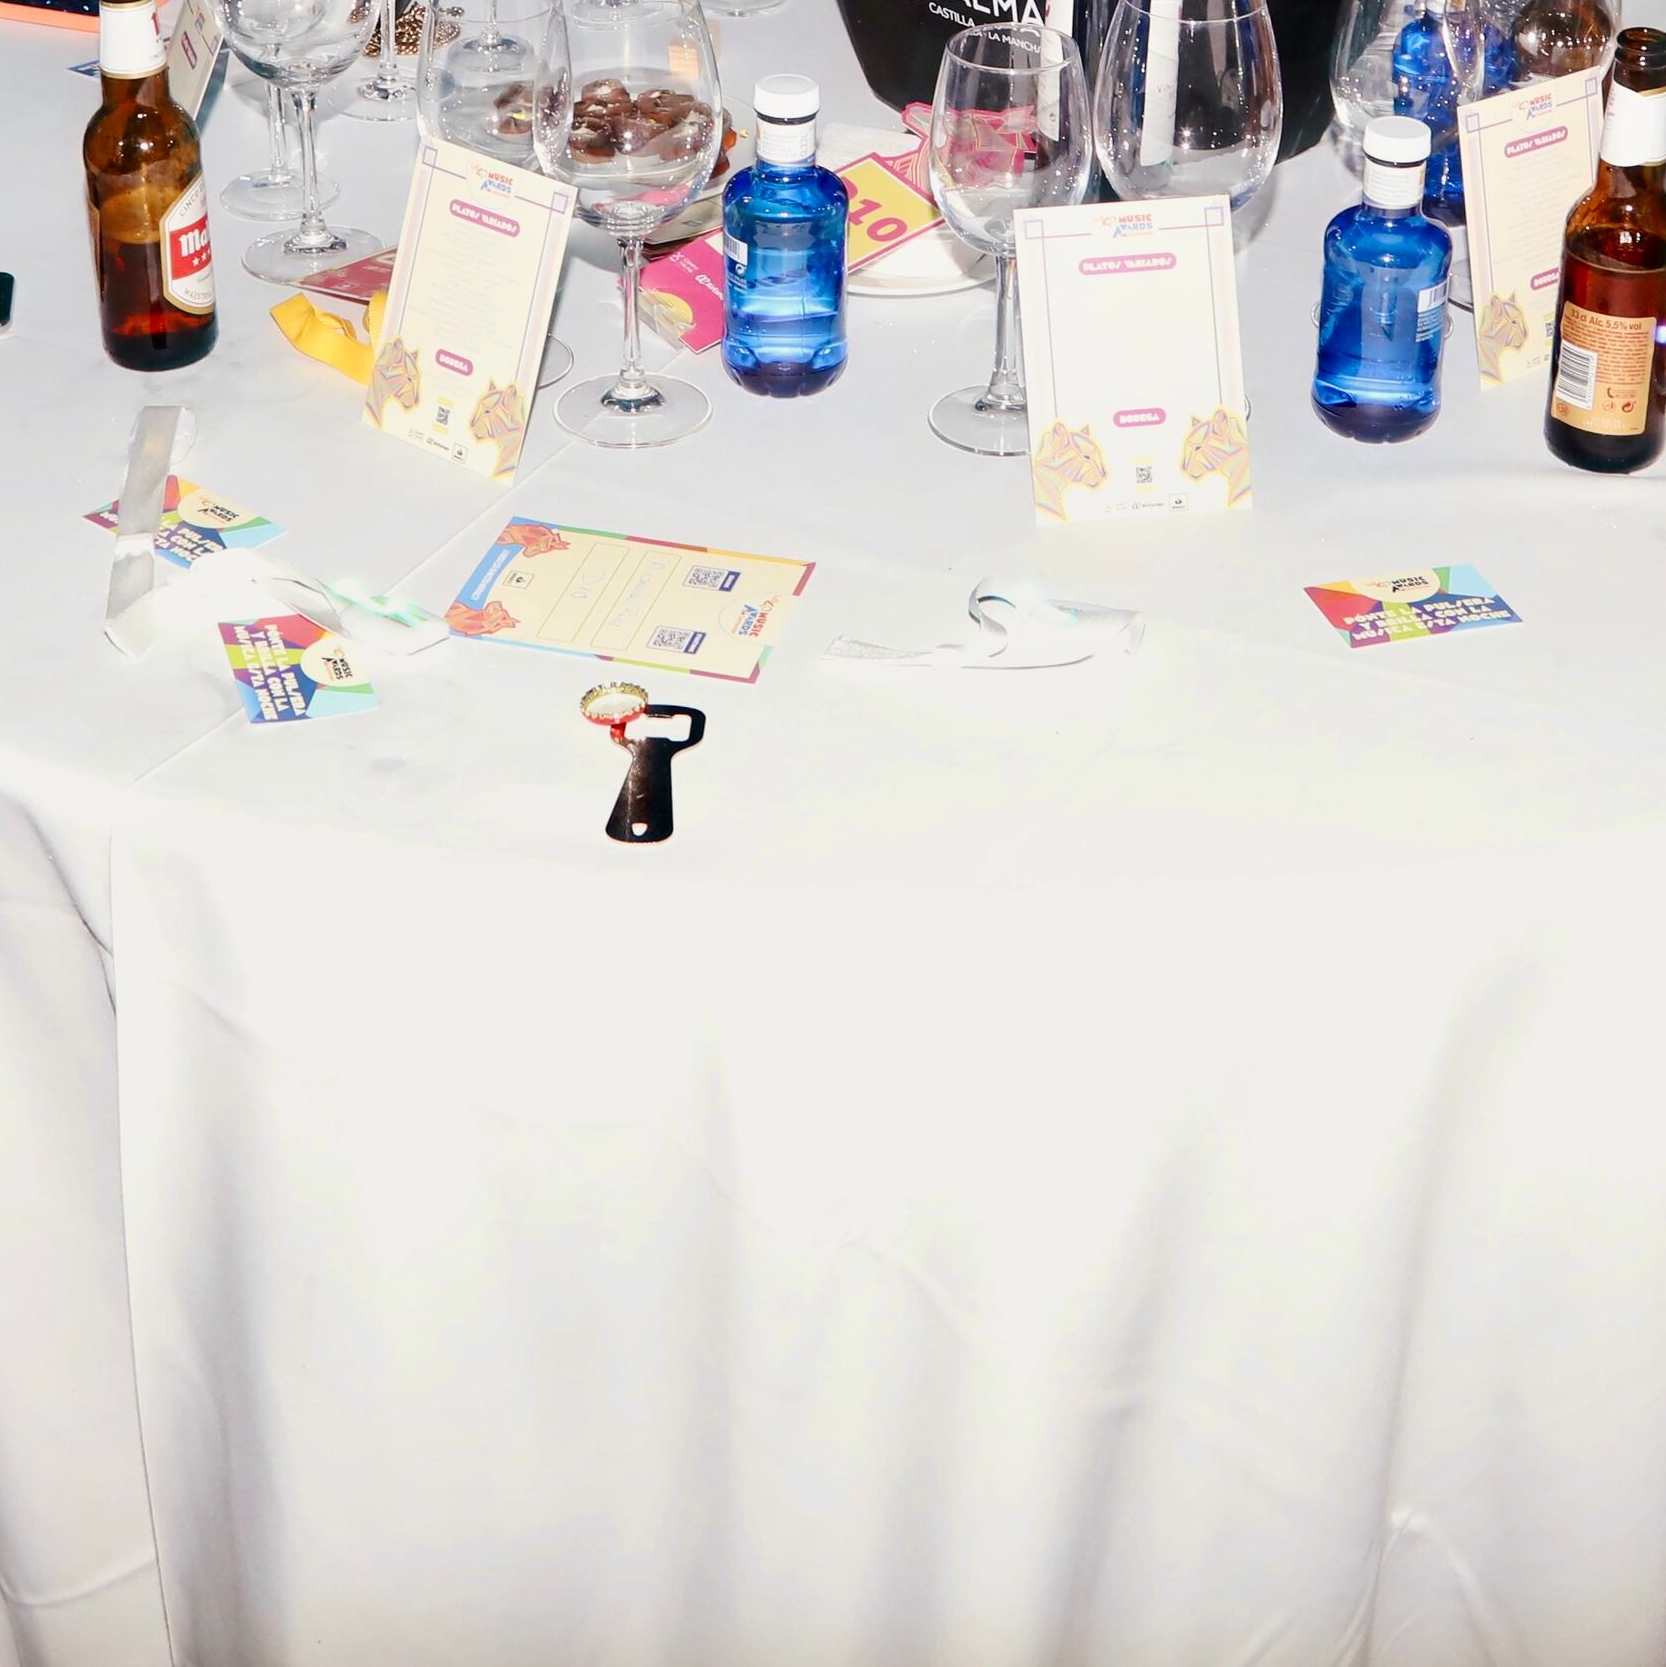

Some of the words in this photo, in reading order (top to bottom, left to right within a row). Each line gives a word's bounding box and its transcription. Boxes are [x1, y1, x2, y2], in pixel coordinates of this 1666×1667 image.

[928, 2, 976, 27] CASTILLA
[488, 171, 513, 186] MUSIC
[451, 203, 480, 219] PLATOS
[480, 213, 518, 233] VARIADOS
[1118, 214, 1153, 223] MUSIC
[1112, 222, 1153, 238] AWARDS
[1082, 260, 1122, 272] PLATOS
[1122, 257, 1172, 269] VARIADOS
[1629, 322, 1642, 330] vol
[1119, 413, 1160, 424] BODEGA
[1391, 576, 1425, 585] MUSIC
[1398, 604, 1422, 615] LA
[1423, 596, 1497, 612] PULSERA
[738, 604, 759, 638] AWARDS
[750, 610, 771, 638] MUSIC
[1359, 621, 1375, 631] Y
[1375, 612, 1433, 629] BRILLA
[1435, 607, 1468, 619] CON
[1469, 604, 1493, 614] LA
[1417, 618, 1457, 631] ESTA
[1457, 609, 1512, 624] NOCHE
[250, 630, 266, 641] Y
[275, 656, 291, 672] LA
[338, 656, 354, 679] MUSIC
[245, 662, 266, 689] ESTA
[266, 676, 287, 697] CON
[280, 670, 307, 717] PULSERA
[254, 688, 280, 721] NOCHE
[274, 697, 291, 712] LA
